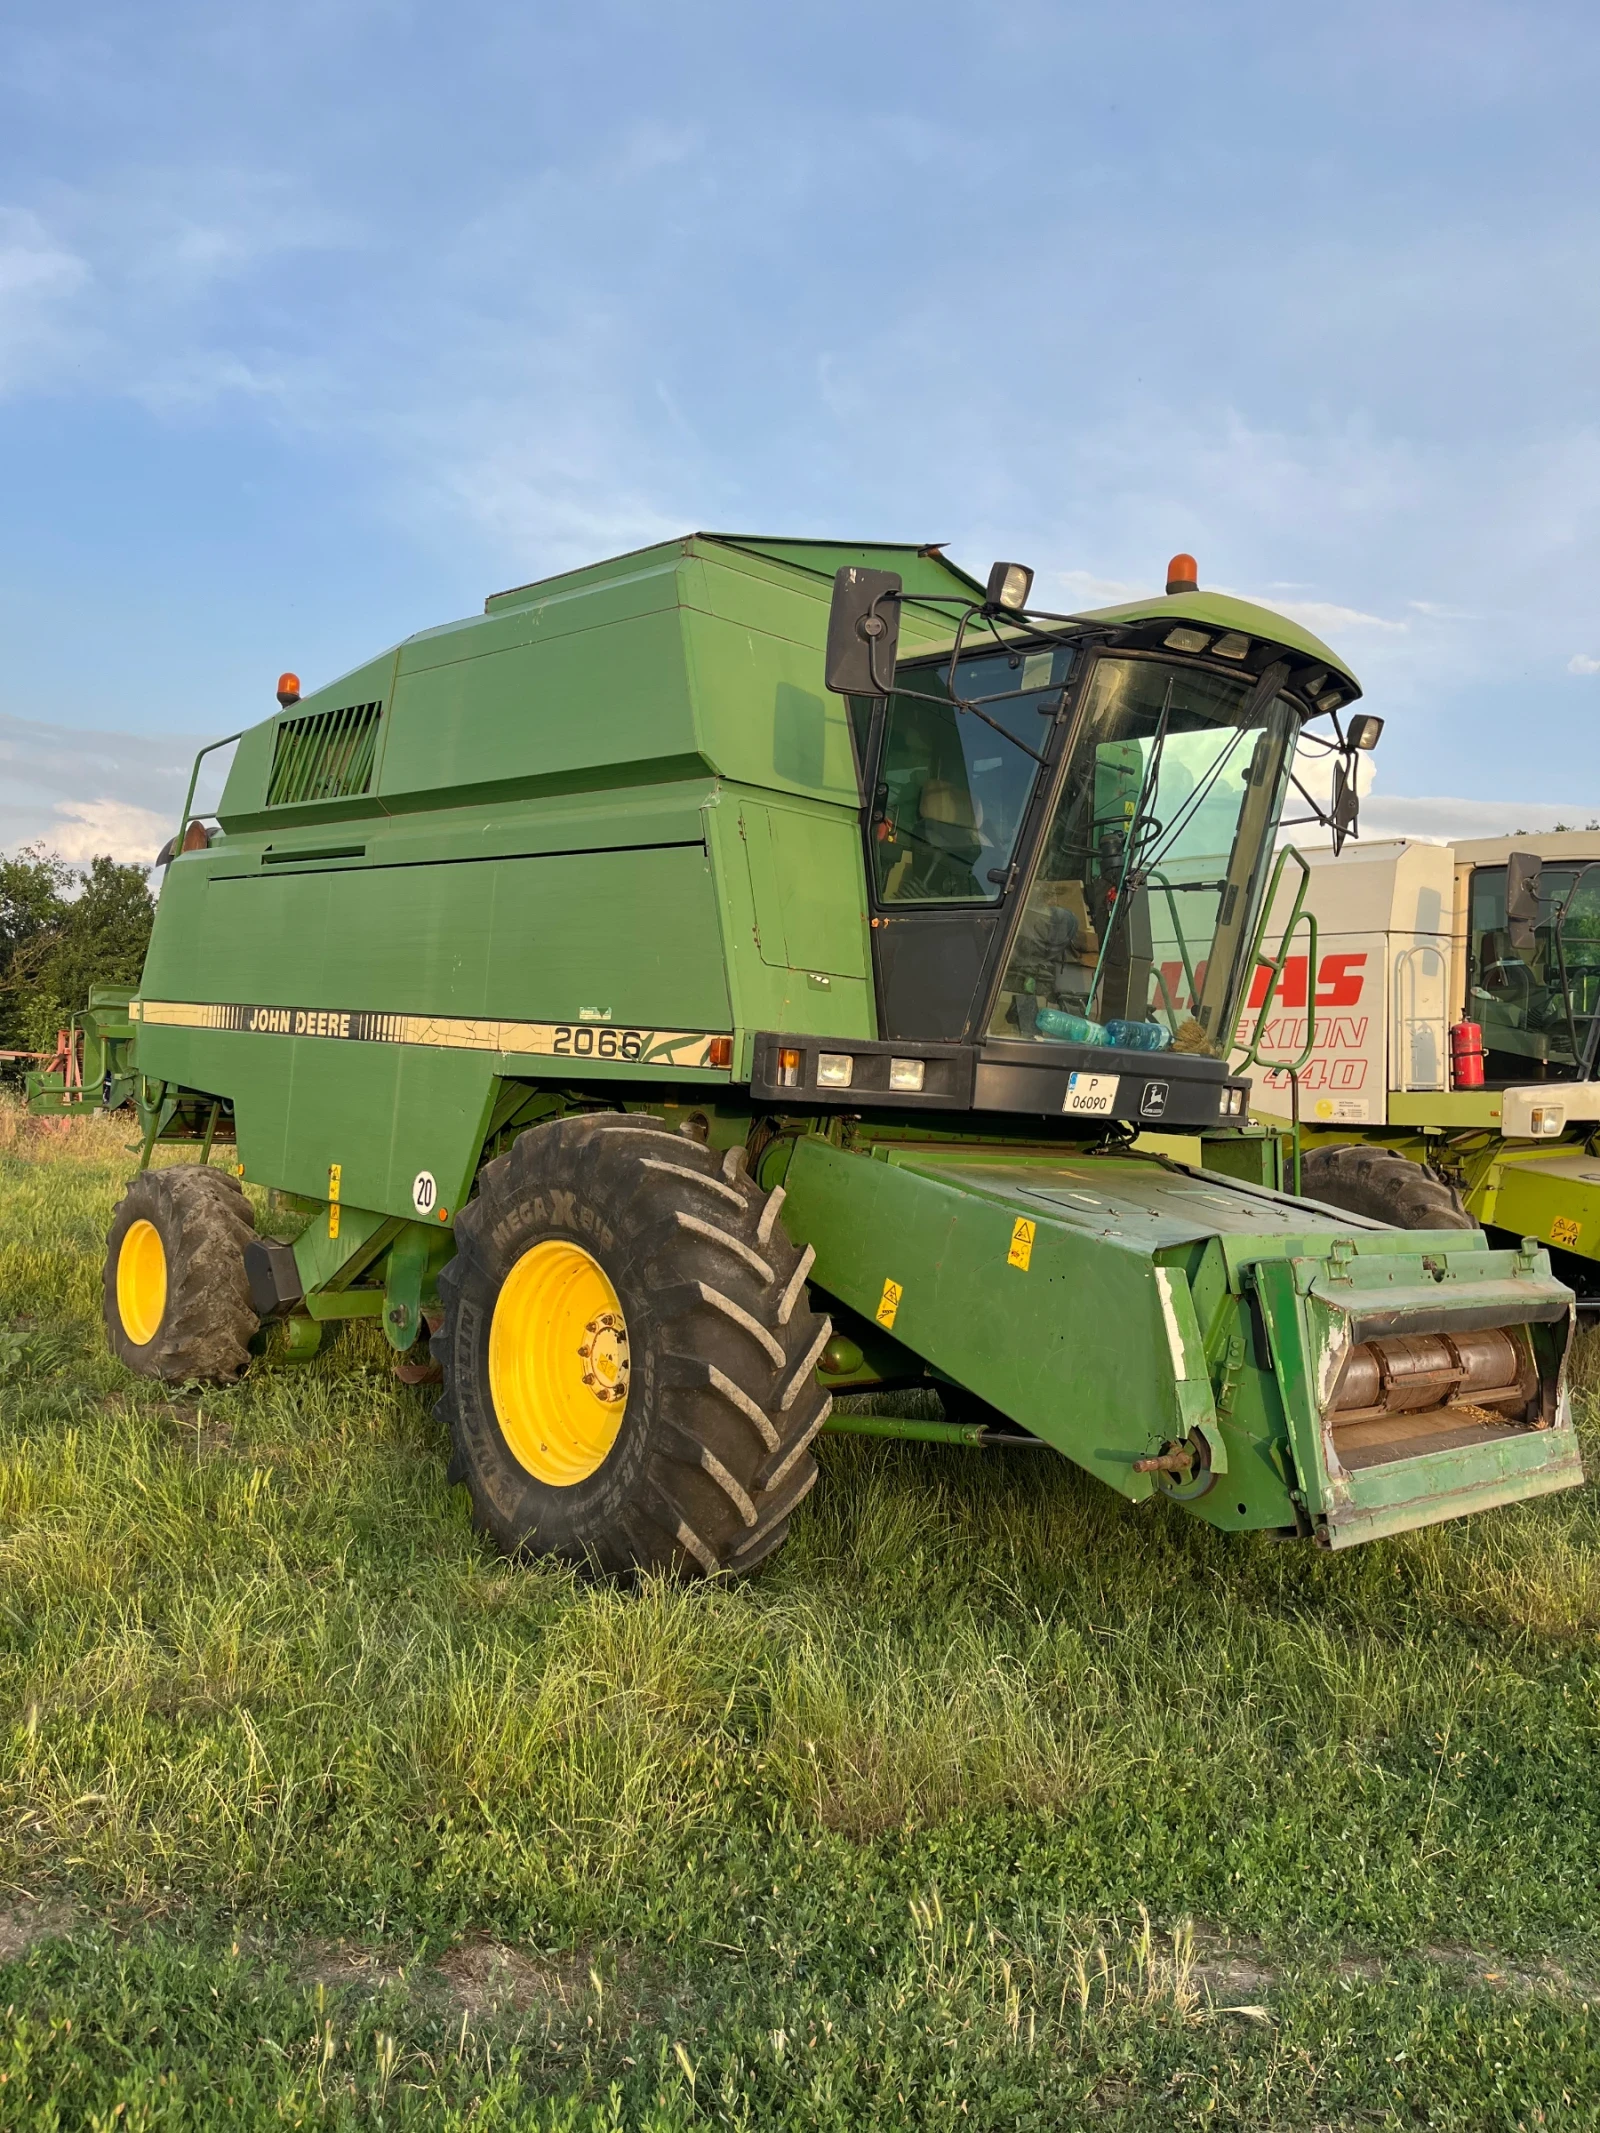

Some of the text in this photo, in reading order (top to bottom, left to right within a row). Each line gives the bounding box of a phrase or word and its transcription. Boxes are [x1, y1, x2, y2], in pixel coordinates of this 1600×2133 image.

[249, 1008, 351, 1038] JOHN DEERE
[553, 1027, 642, 1060] 2066
[1089, 1078, 1099, 1092] P
[1263, 1059, 1368, 1090] 440
[1072, 1095, 1107, 1110] 06090
[416, 1177, 433, 1207] 20
[491, 1197, 548, 1250] MEGA
